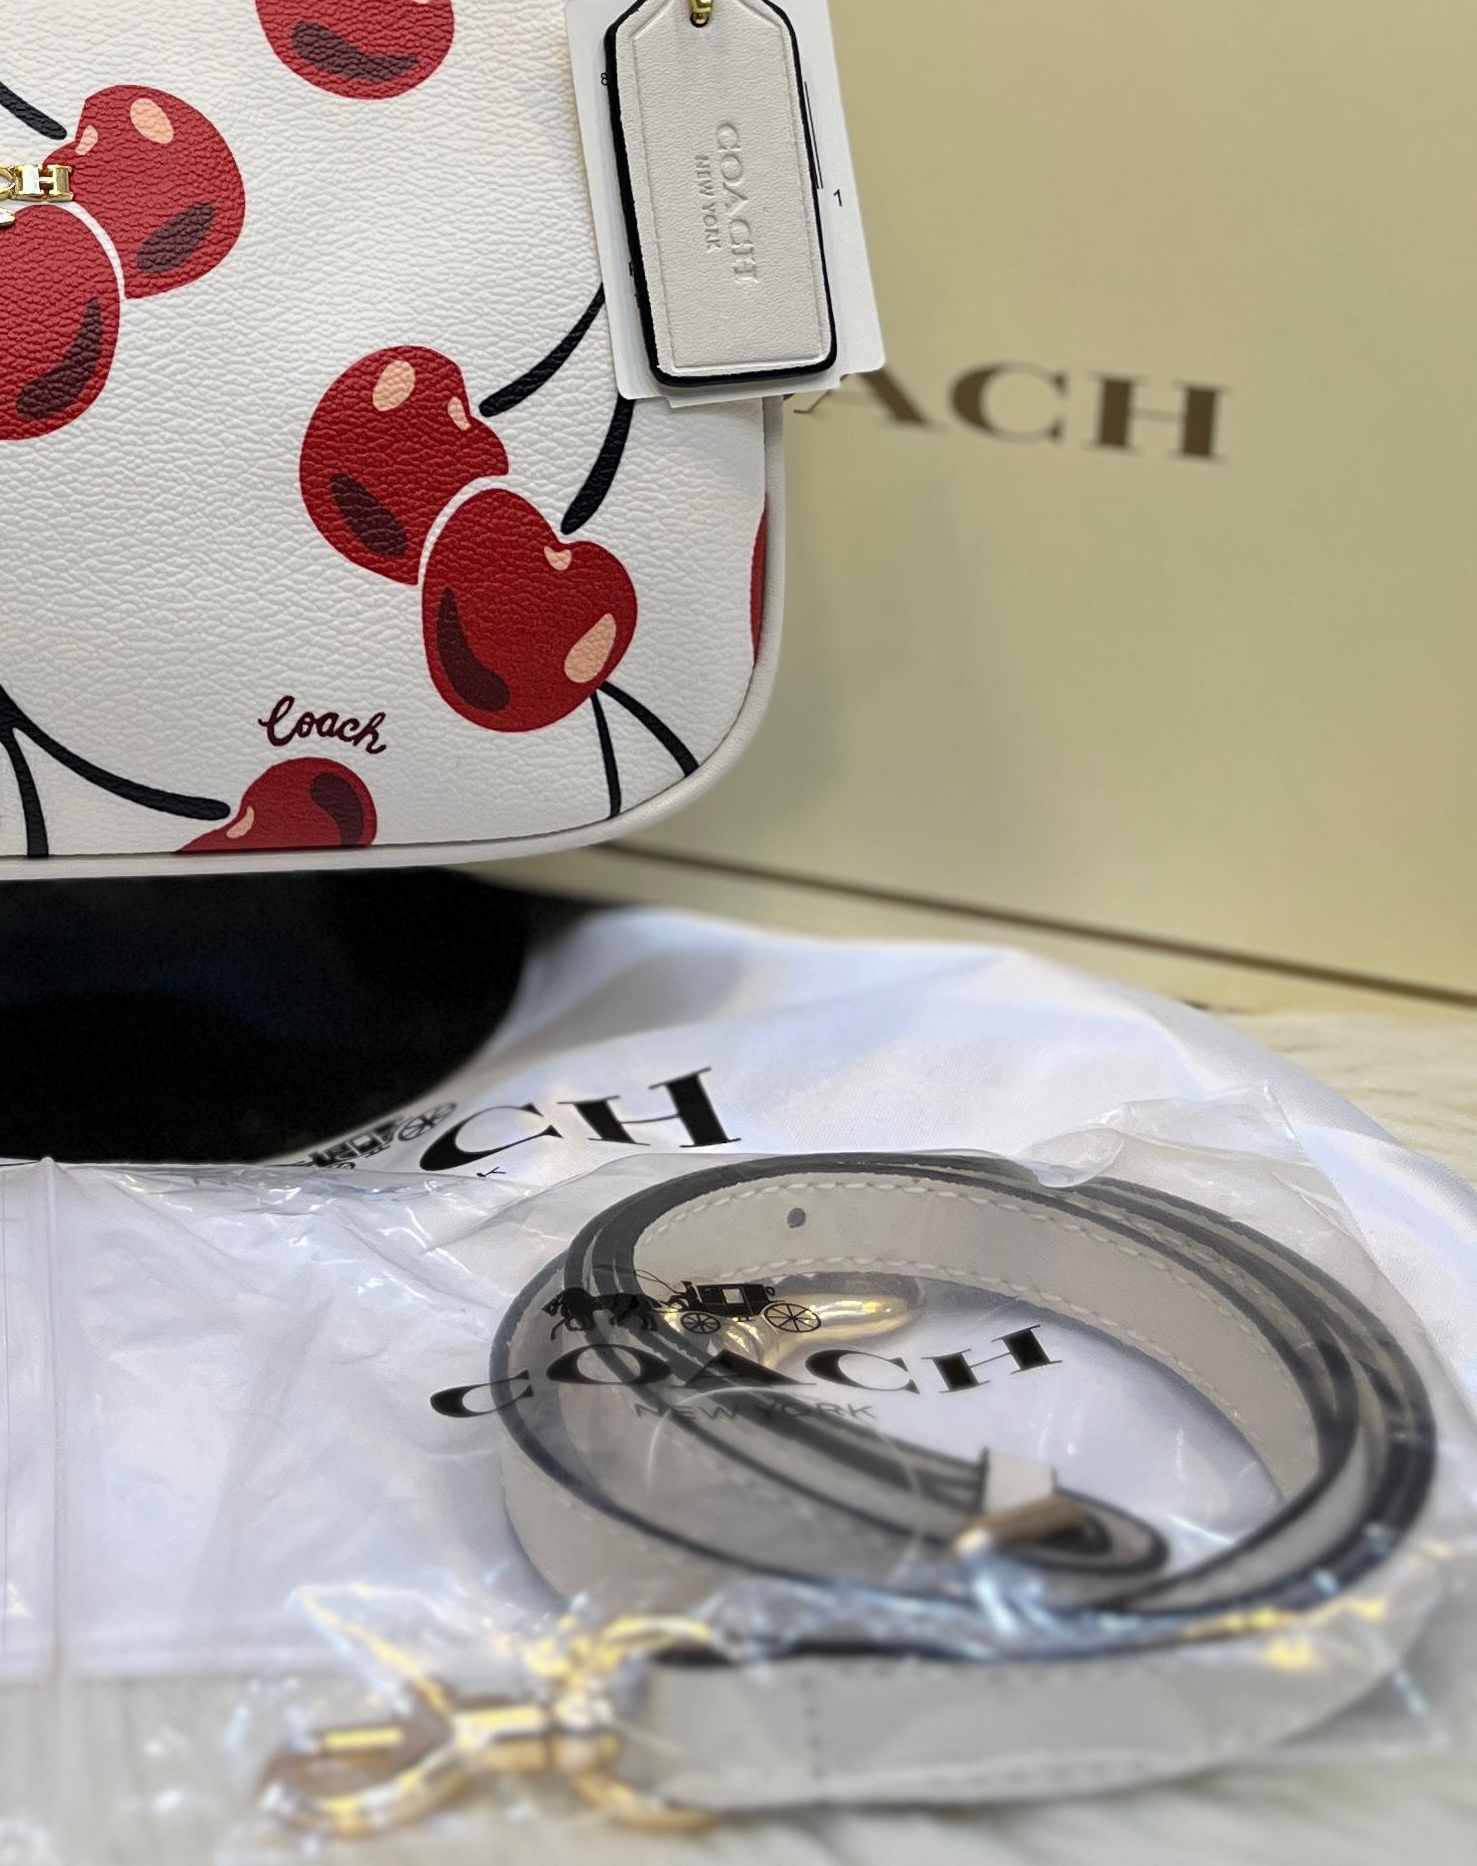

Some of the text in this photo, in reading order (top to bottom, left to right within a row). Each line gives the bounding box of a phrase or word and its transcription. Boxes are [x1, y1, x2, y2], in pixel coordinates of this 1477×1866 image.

[695, 154, 722, 255] NEW YORK
[716, 122, 760, 284] COACH
[257, 694, 388, 755] Coach
[429, 1324, 1064, 1419] COACH
[634, 1400, 878, 1422] NEW YORK
